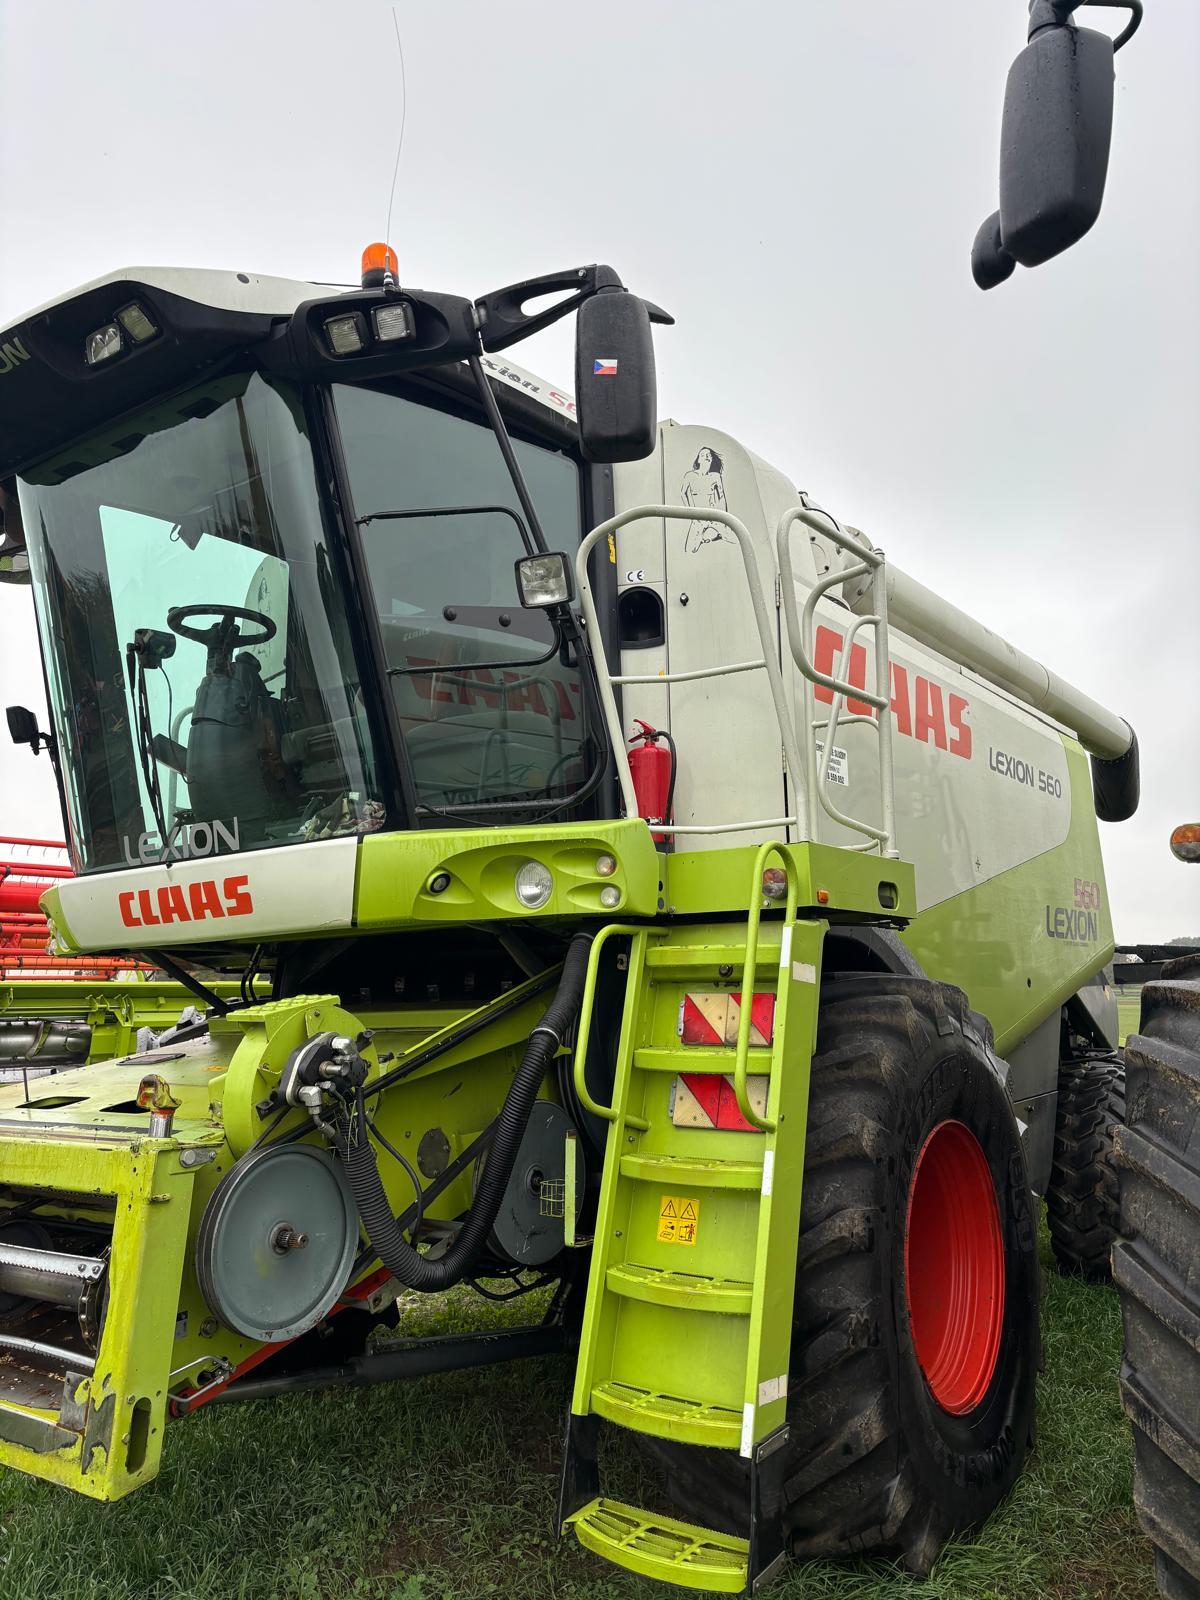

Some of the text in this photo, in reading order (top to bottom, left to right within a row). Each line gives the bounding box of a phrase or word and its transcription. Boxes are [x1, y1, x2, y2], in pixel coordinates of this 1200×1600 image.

[814, 625, 972, 760] CLAAS
[989, 747, 1062, 798] LEXION 560
[124, 816, 241, 867] LEXION
[118, 875, 254, 927] CLAAS
[1073, 877, 1101, 910] 560
[1046, 905, 1098, 941] LEXION
